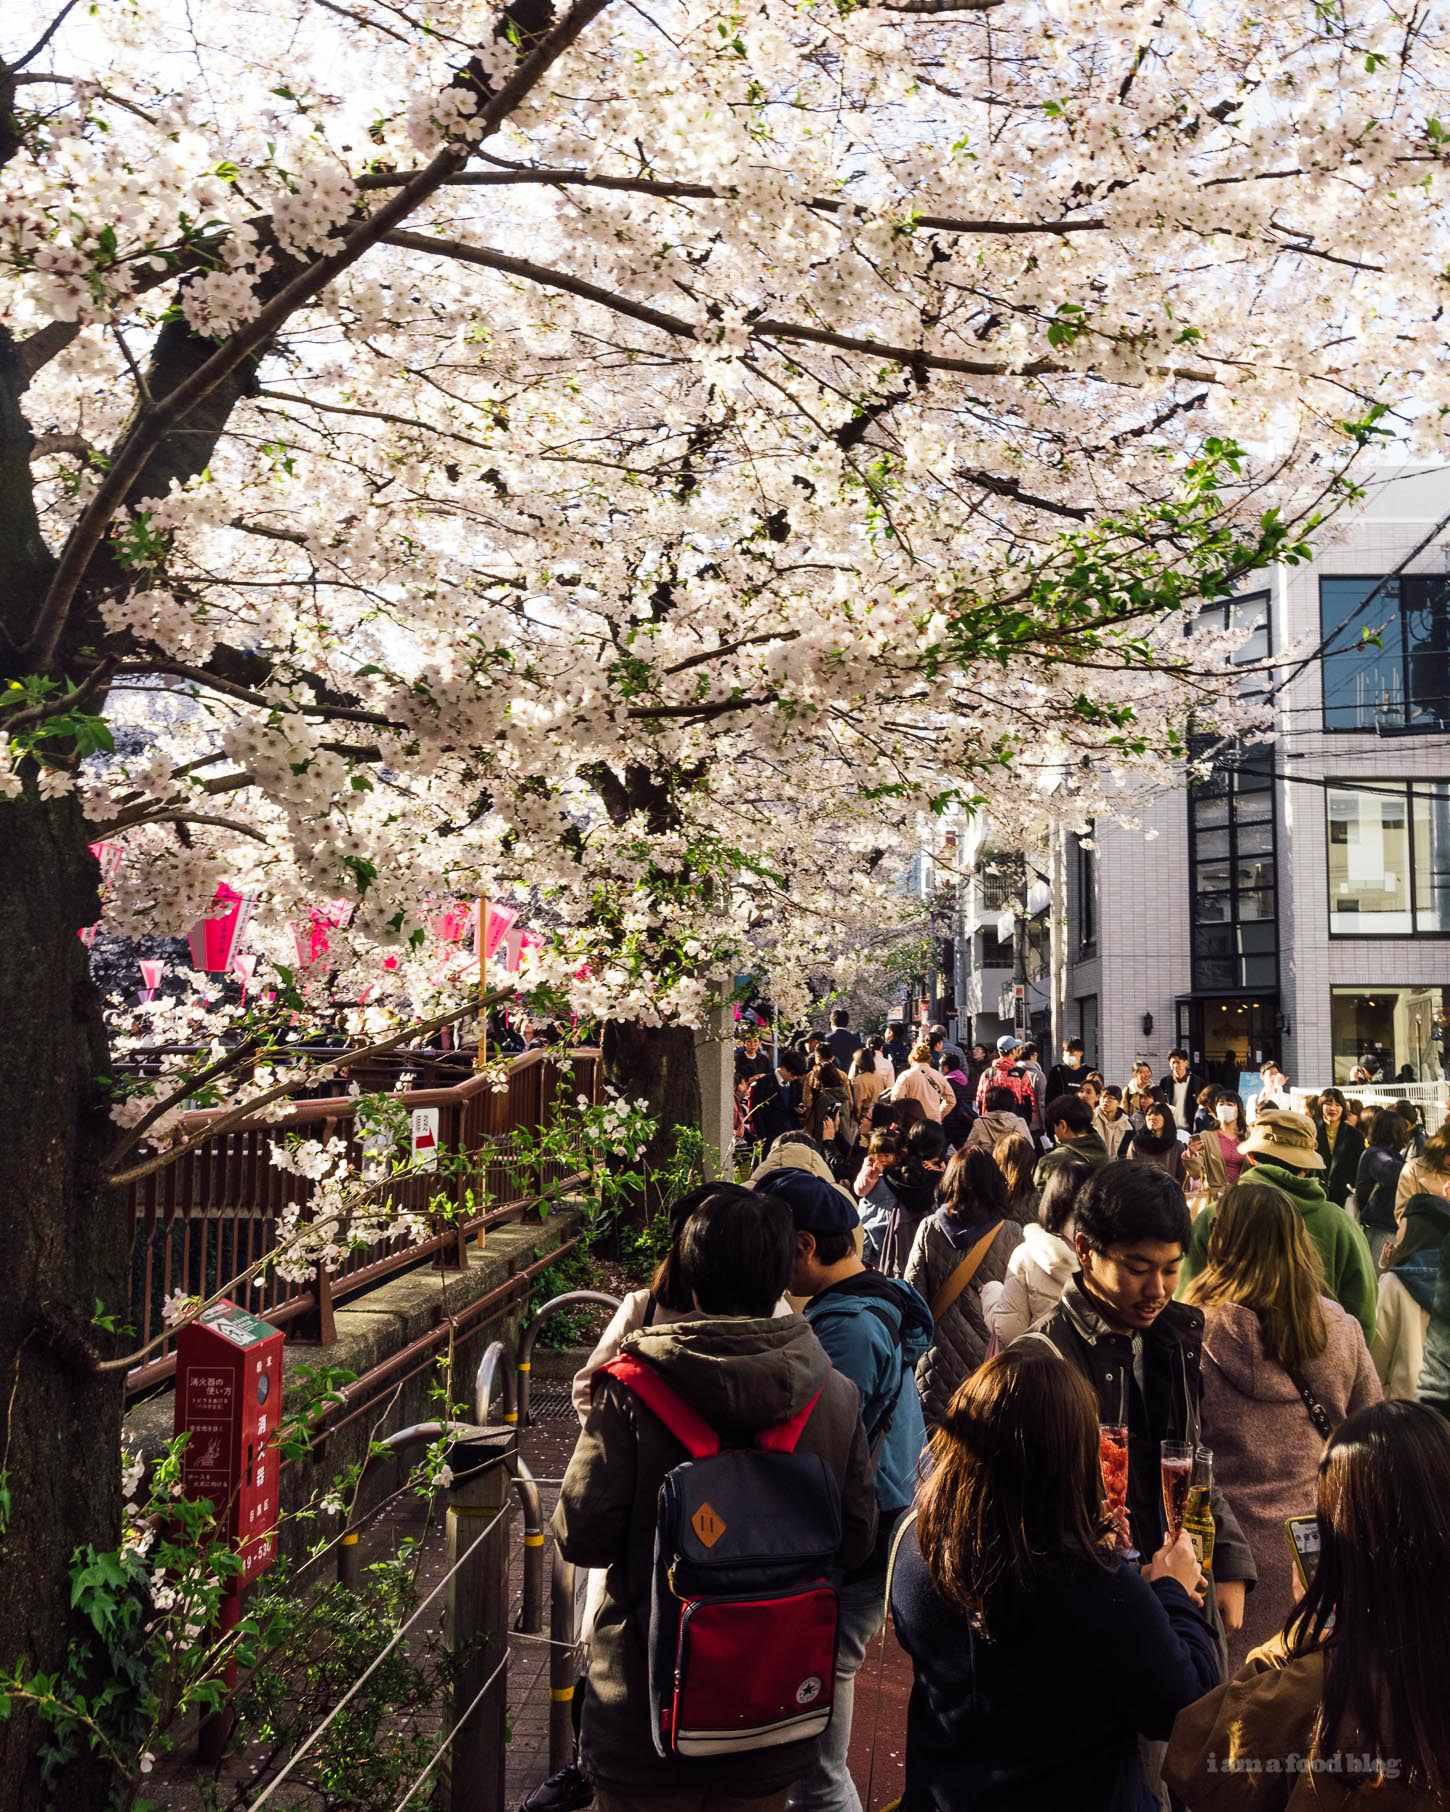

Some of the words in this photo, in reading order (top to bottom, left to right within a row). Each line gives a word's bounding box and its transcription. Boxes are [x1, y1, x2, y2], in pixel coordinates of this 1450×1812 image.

[190, 1377, 224, 1387] 消火器の
[206, 1387, 232, 1396] 使い方
[256, 1414, 268, 1487] 消火器
